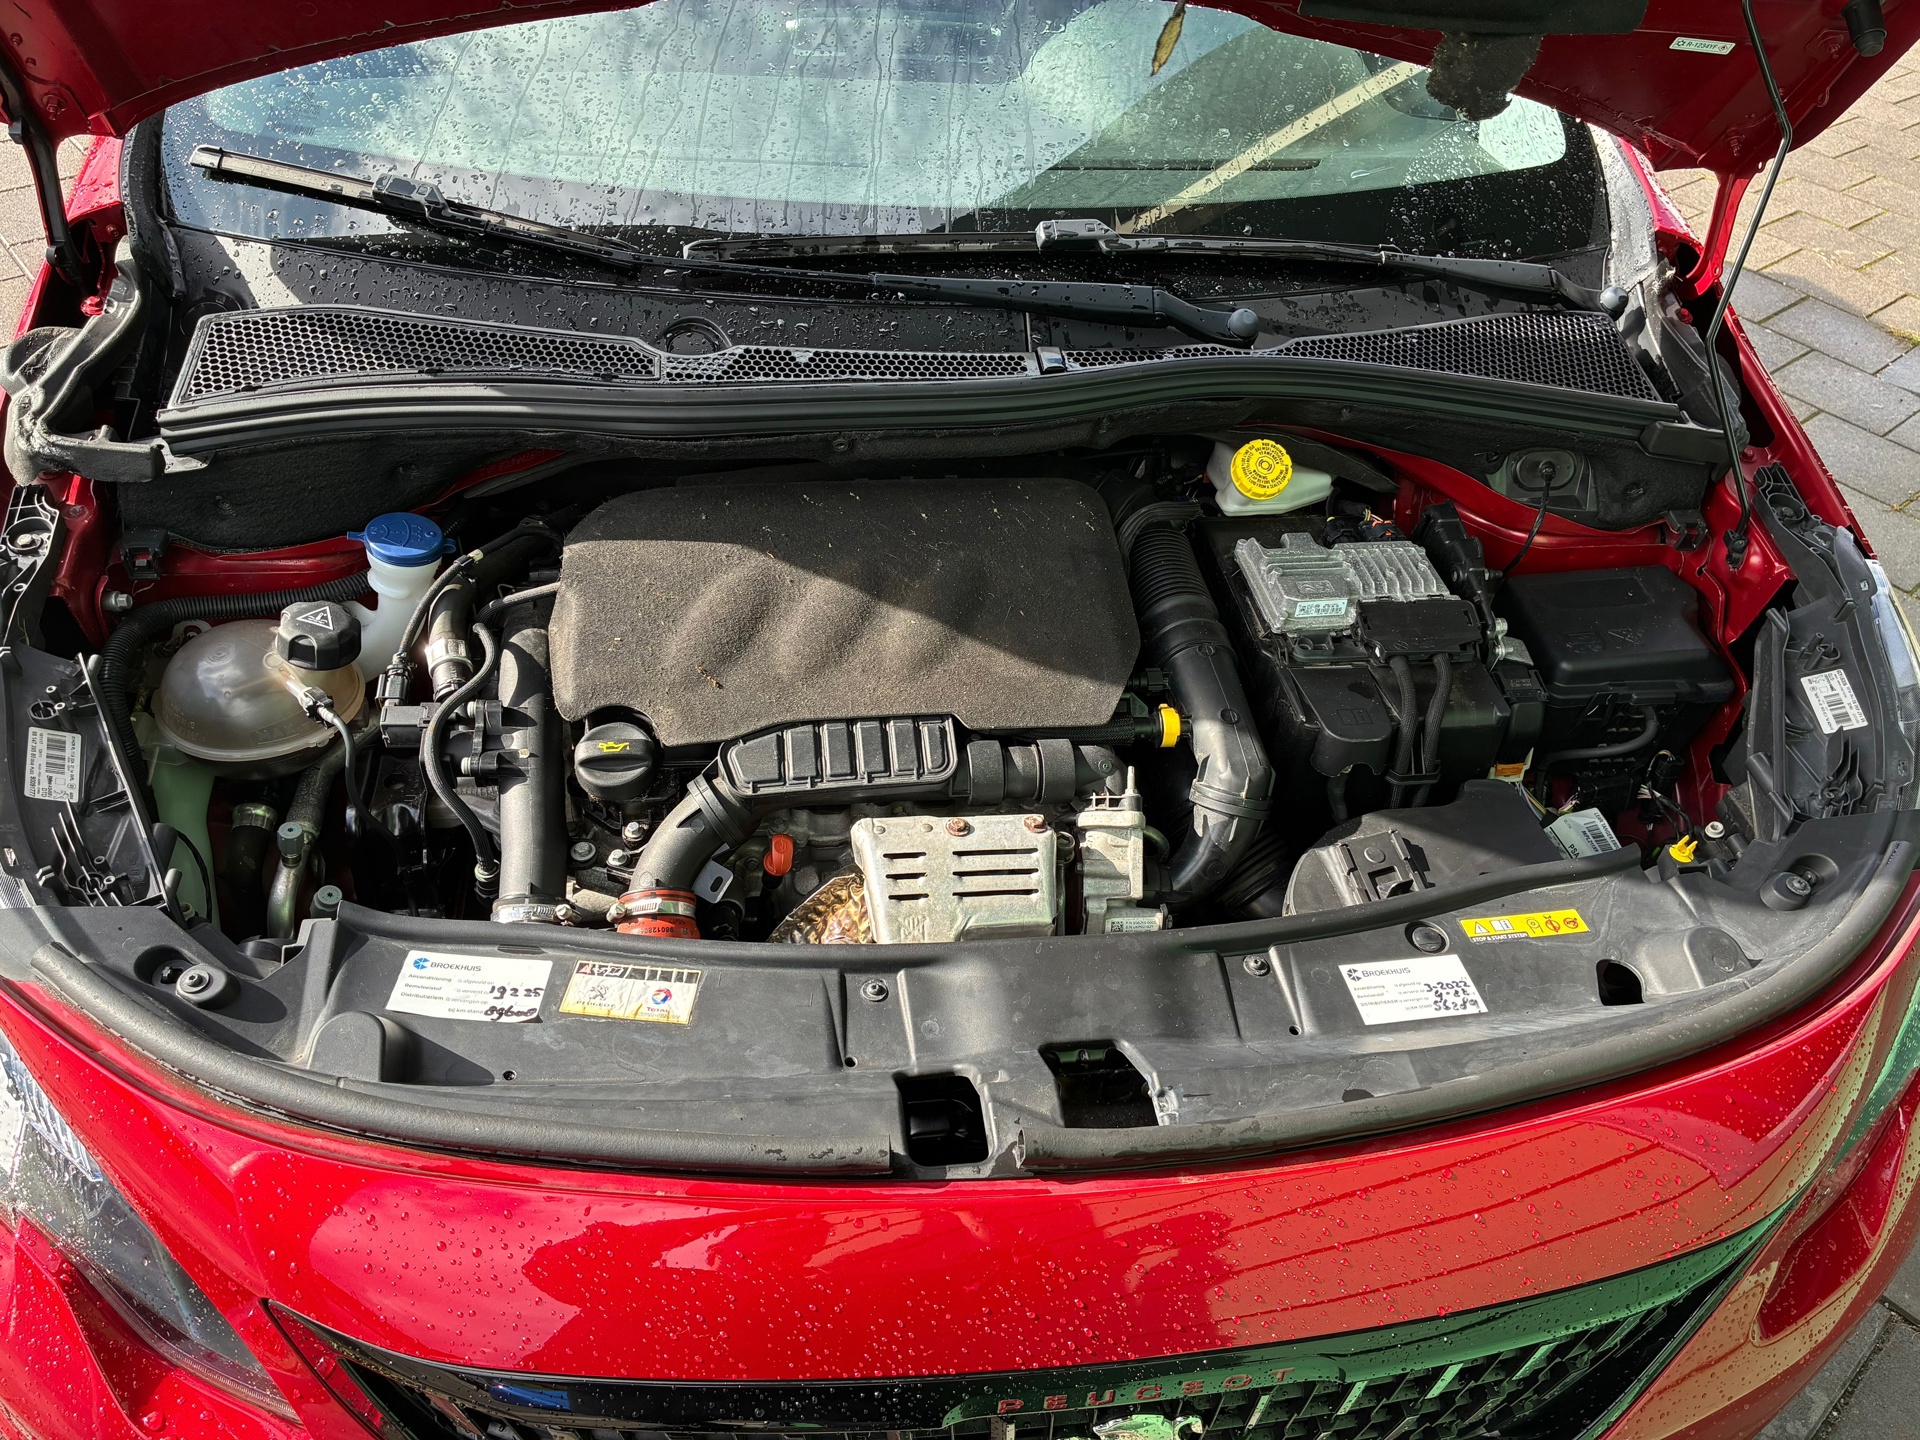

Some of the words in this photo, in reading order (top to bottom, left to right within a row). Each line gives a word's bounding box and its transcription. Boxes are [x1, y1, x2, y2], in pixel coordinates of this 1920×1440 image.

[1568, 844, 1580, 858] PSA
[430, 962, 482, 972] BROEKHUIS
[1361, 967, 1411, 978] BROEKHUIS
[998, 1368, 1295, 1414] PEUGEOT
